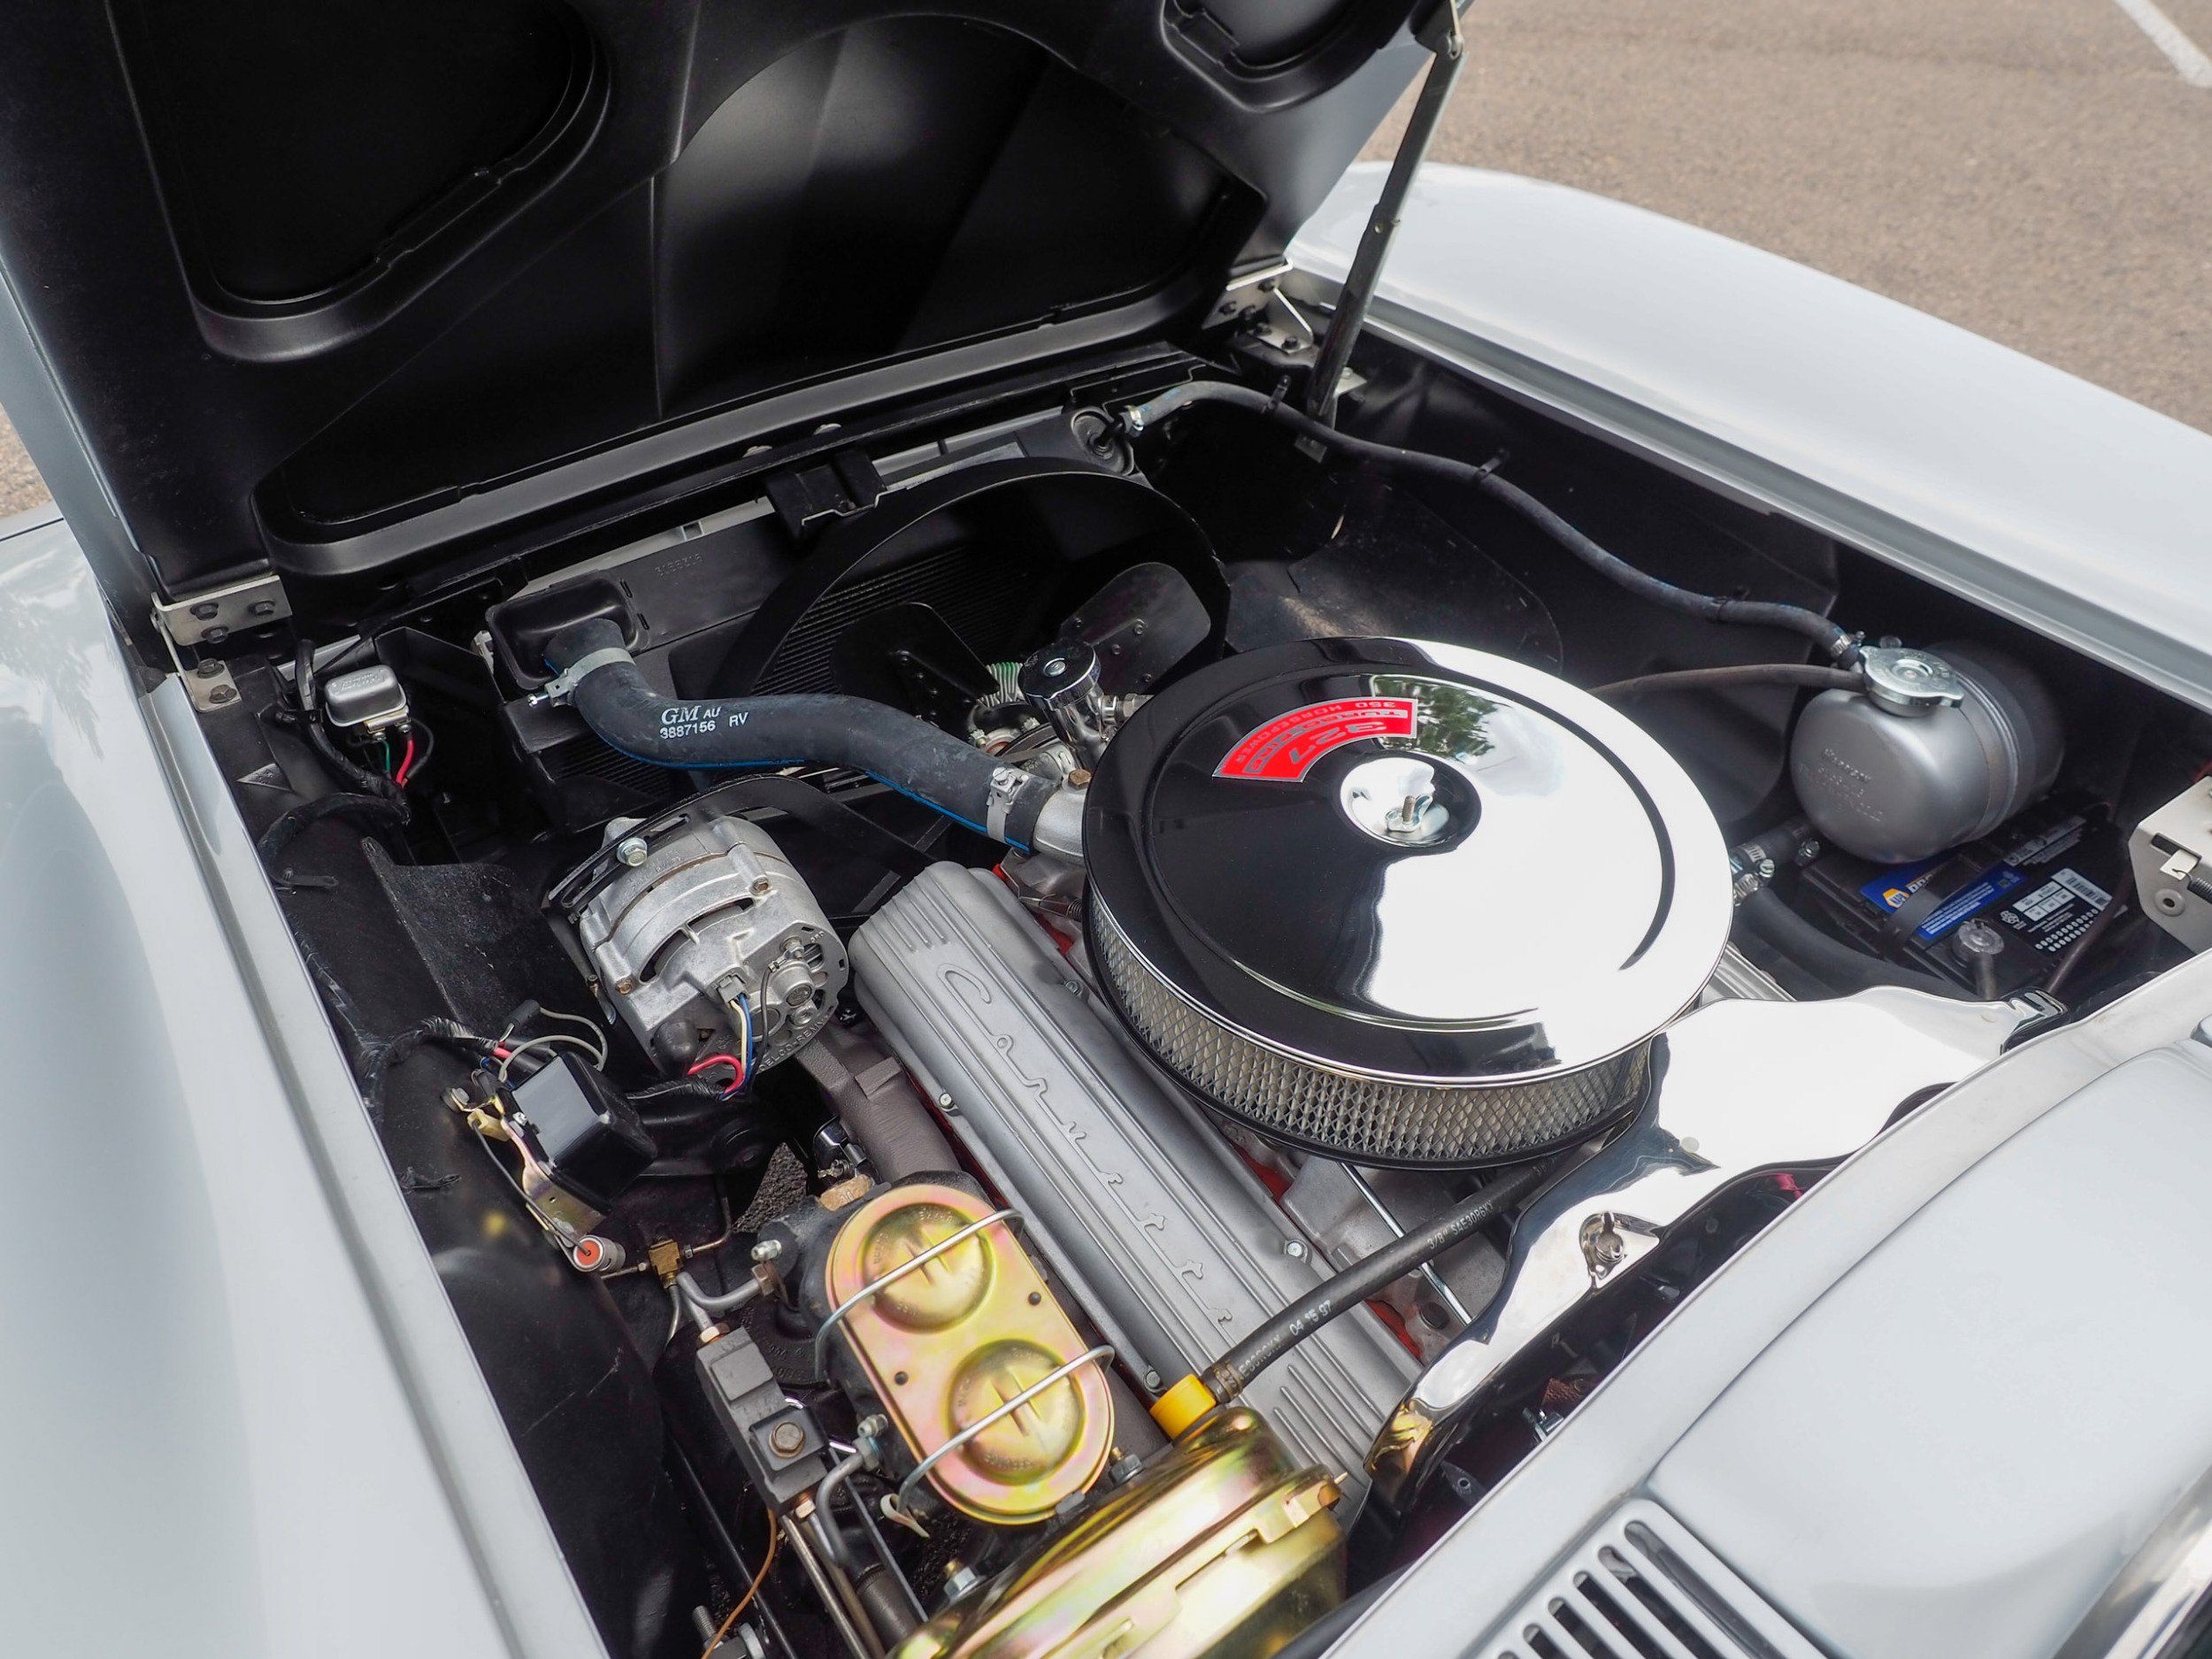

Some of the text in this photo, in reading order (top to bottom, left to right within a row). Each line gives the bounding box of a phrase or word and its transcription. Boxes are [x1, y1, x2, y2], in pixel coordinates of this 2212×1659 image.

[659, 712, 749, 740] 3887156 RV
[661, 705, 722, 726] GM AU
[1235, 703, 1342, 762] HORSEPOWER
[1288, 721, 1387, 764] 327
[936, 962, 1236, 1345] Corvette
[1289, 1322, 1303, 1336] 04
